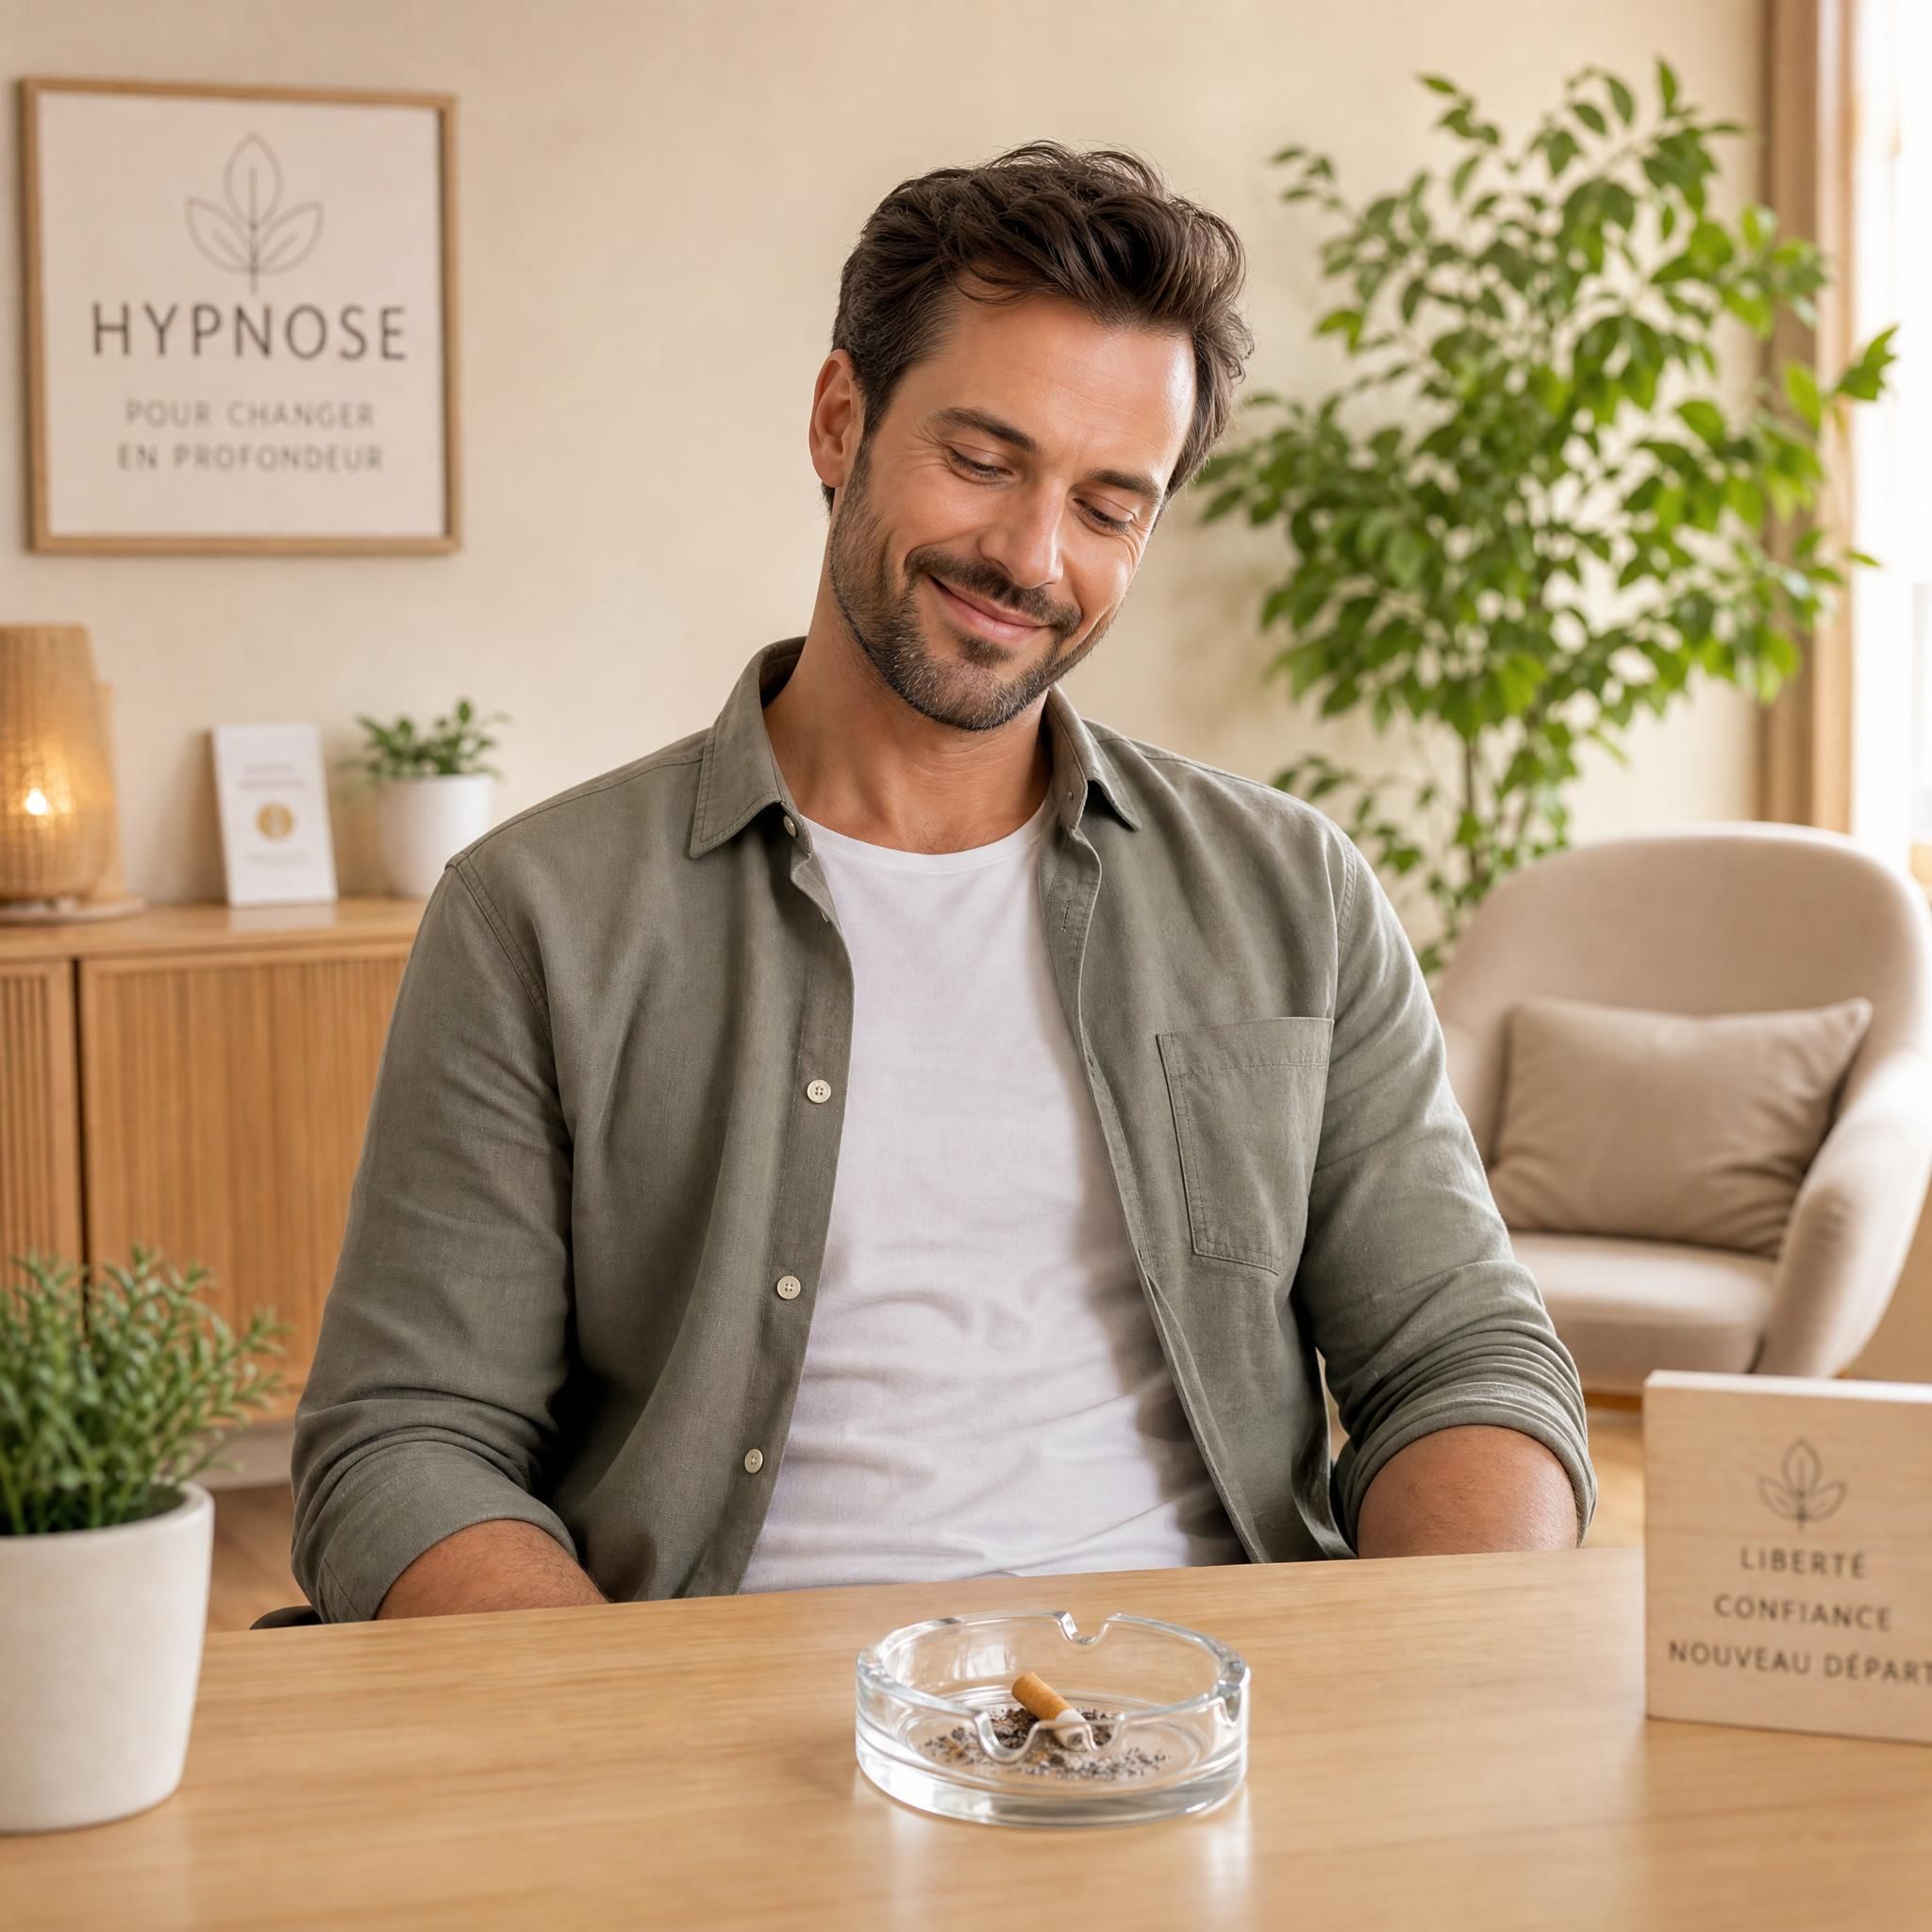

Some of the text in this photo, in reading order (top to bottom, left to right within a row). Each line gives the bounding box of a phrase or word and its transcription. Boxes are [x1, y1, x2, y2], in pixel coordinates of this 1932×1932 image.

[92, 301, 408, 362] HYPNOSE
[125, 400, 375, 430] POUR CHANGER
[118, 443, 384, 472] EN PROFONDEUR
[1740, 1547, 1866, 1579] LIBERTÉ
[1714, 1593, 1892, 1632] CONFIANCE
[1668, 1640, 1811, 1676] NOUVEAU
